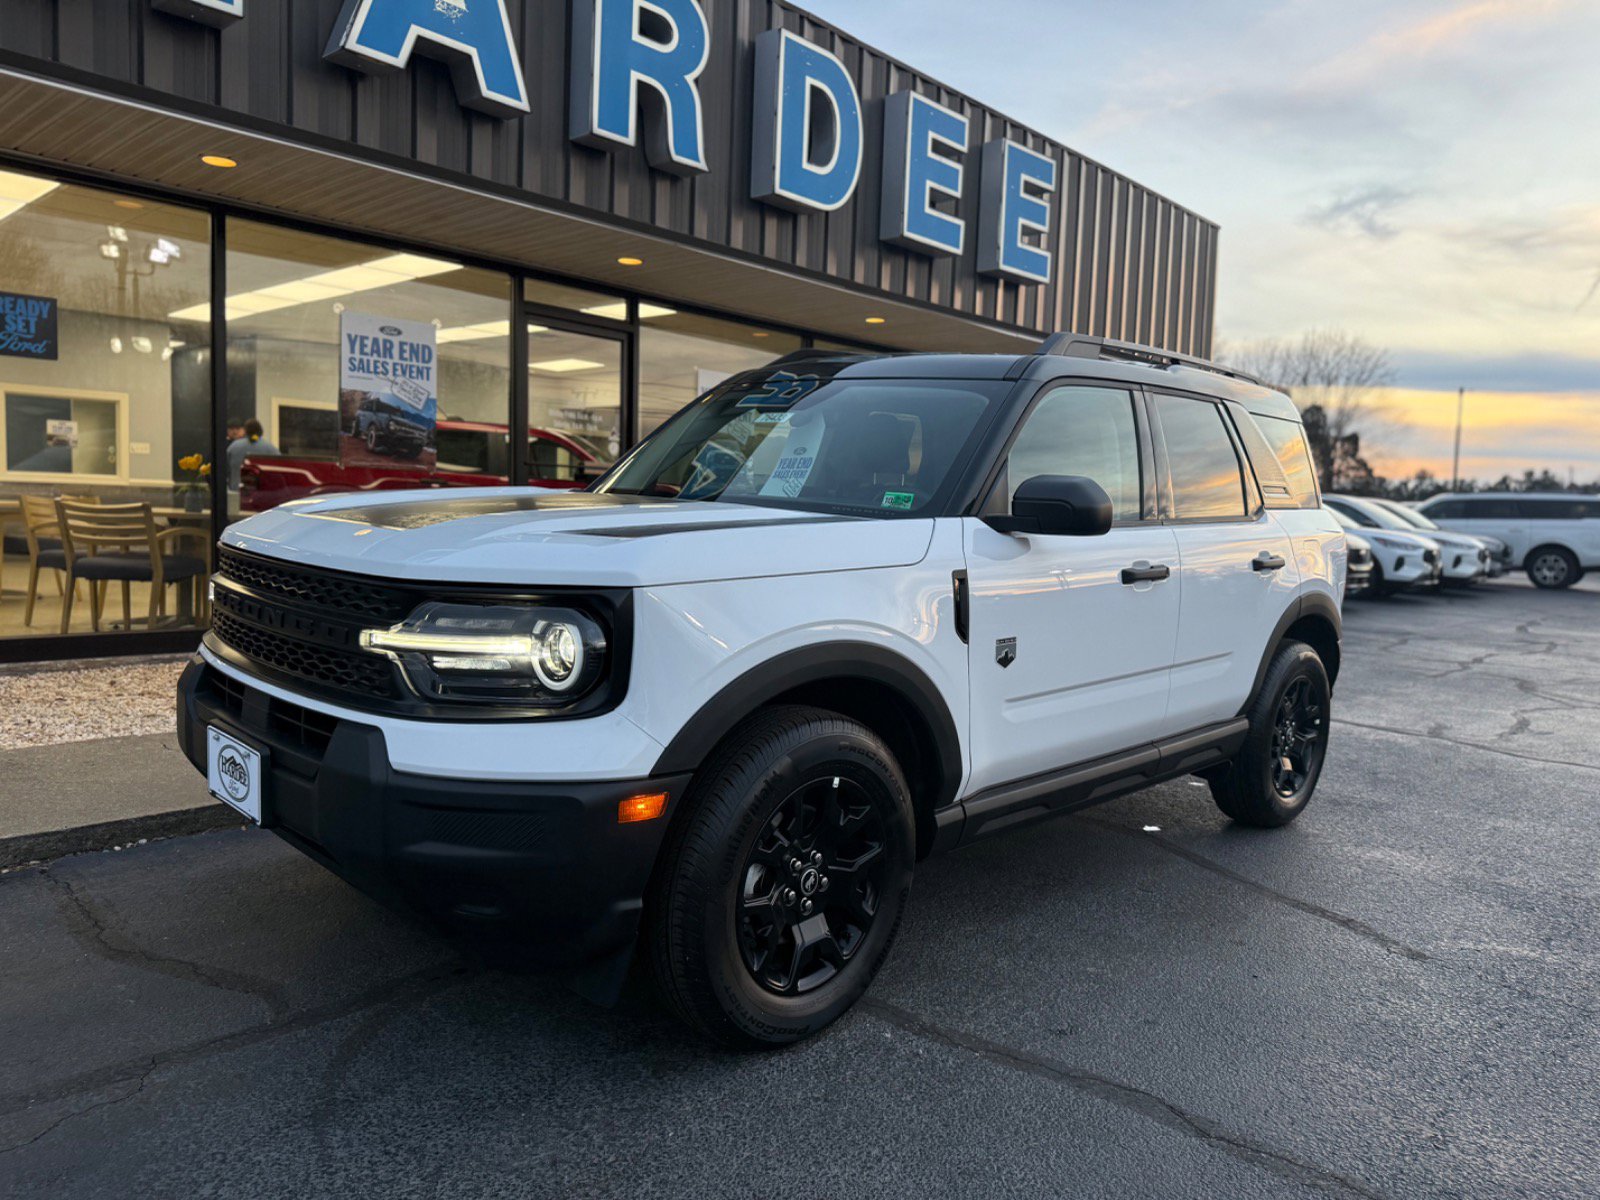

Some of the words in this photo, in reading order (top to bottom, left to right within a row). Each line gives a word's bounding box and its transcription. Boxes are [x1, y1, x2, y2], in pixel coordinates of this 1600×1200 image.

[184, 0, 1057, 284] ARDEE
[4, 314, 37, 334] SET
[347, 333, 394, 359] YEAR
[399, 341, 433, 364] END
[348, 356, 390, 376] SALES
[393, 362, 431, 381] EVENT
[777, 457, 798, 469] YEAR
[796, 457, 813, 469] END
